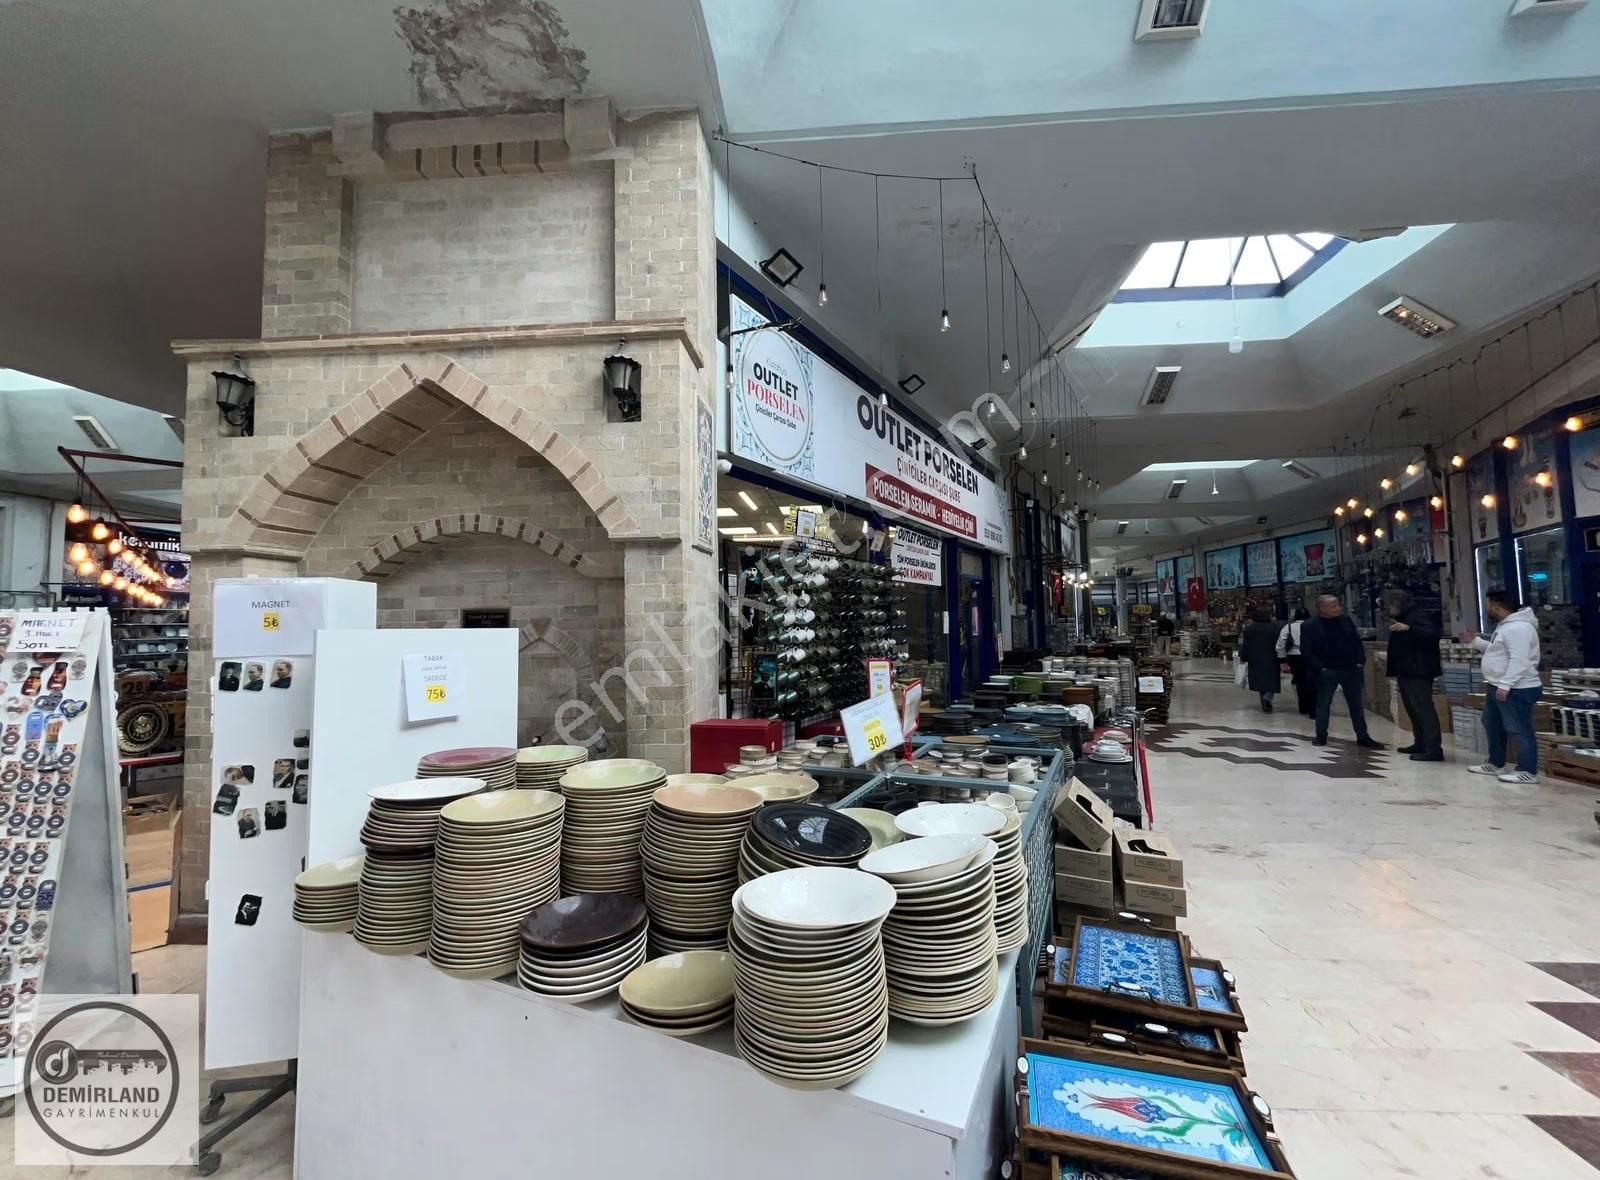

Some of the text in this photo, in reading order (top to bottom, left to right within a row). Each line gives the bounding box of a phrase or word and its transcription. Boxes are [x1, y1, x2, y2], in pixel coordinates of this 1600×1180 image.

[747, 379, 805, 423] PORSELEN
[753, 362, 799, 401] OUTLET
[857, 395, 979, 497] OUTLET PORSELEN
[873, 476, 911, 510] PORSELEN
[910, 493, 937, 520] SERAMİK
[21, 618, 77, 628] MAGNET
[251, 600, 291, 609] MAGNET
